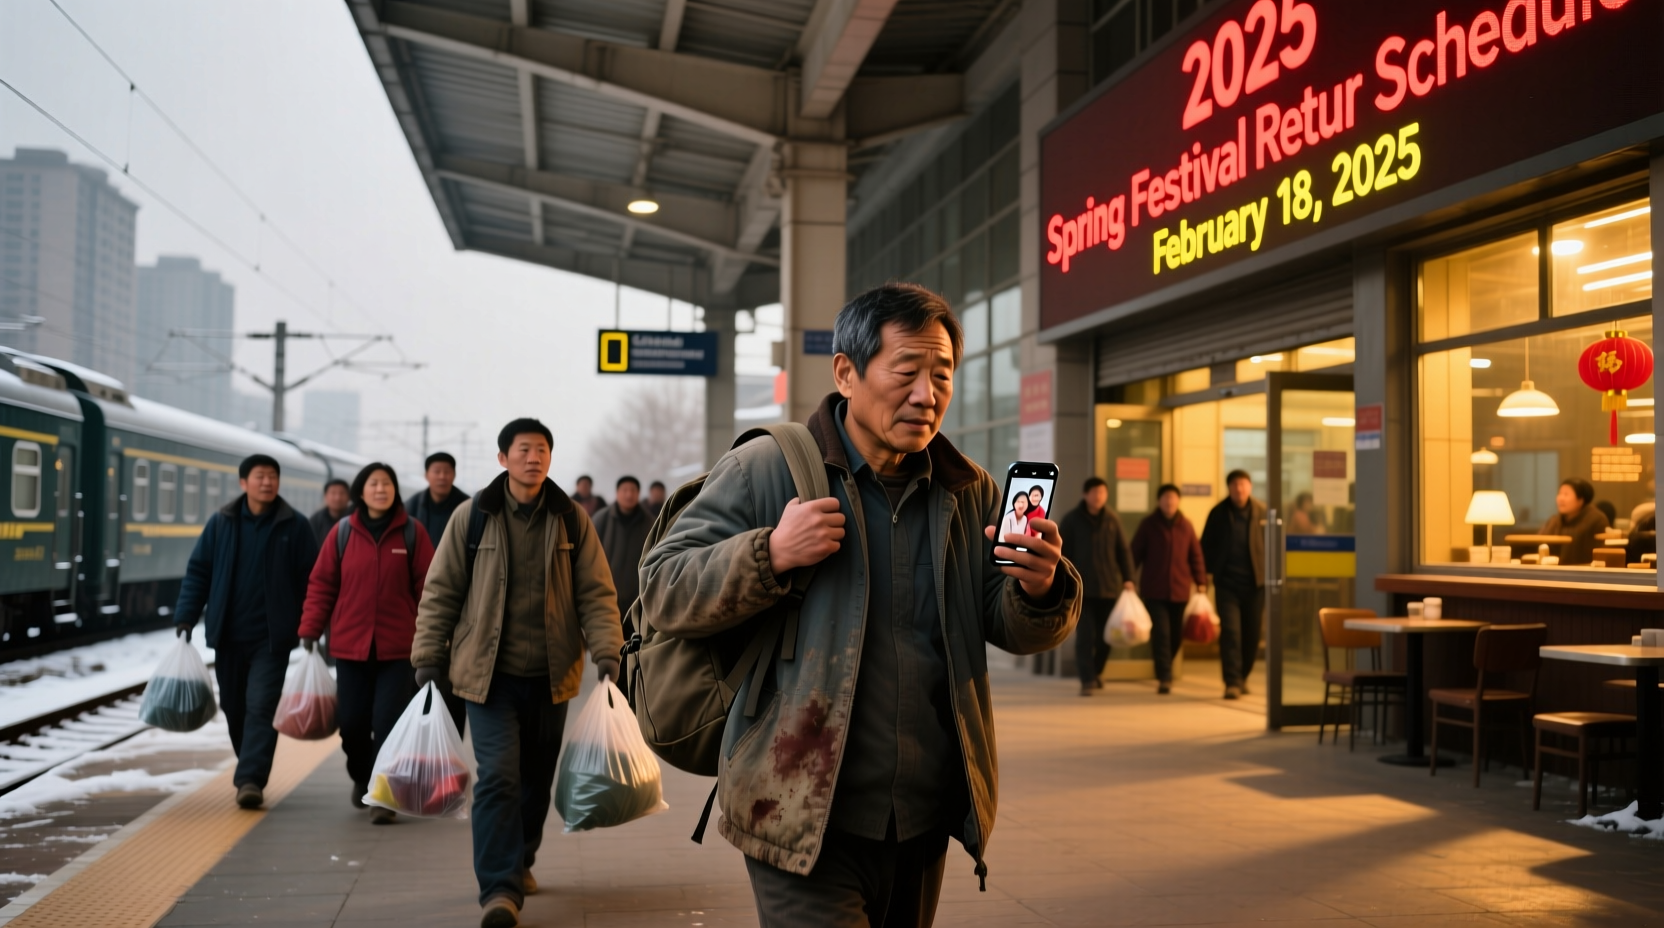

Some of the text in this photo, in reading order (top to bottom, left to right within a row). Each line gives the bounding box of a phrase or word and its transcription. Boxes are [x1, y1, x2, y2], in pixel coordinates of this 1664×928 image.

[1047, 0, 1628, 273] Spring Festival Retur Schedu
[1182, 0, 1317, 130] 2025
[1152, 122, 1421, 275] February 18, 2025
